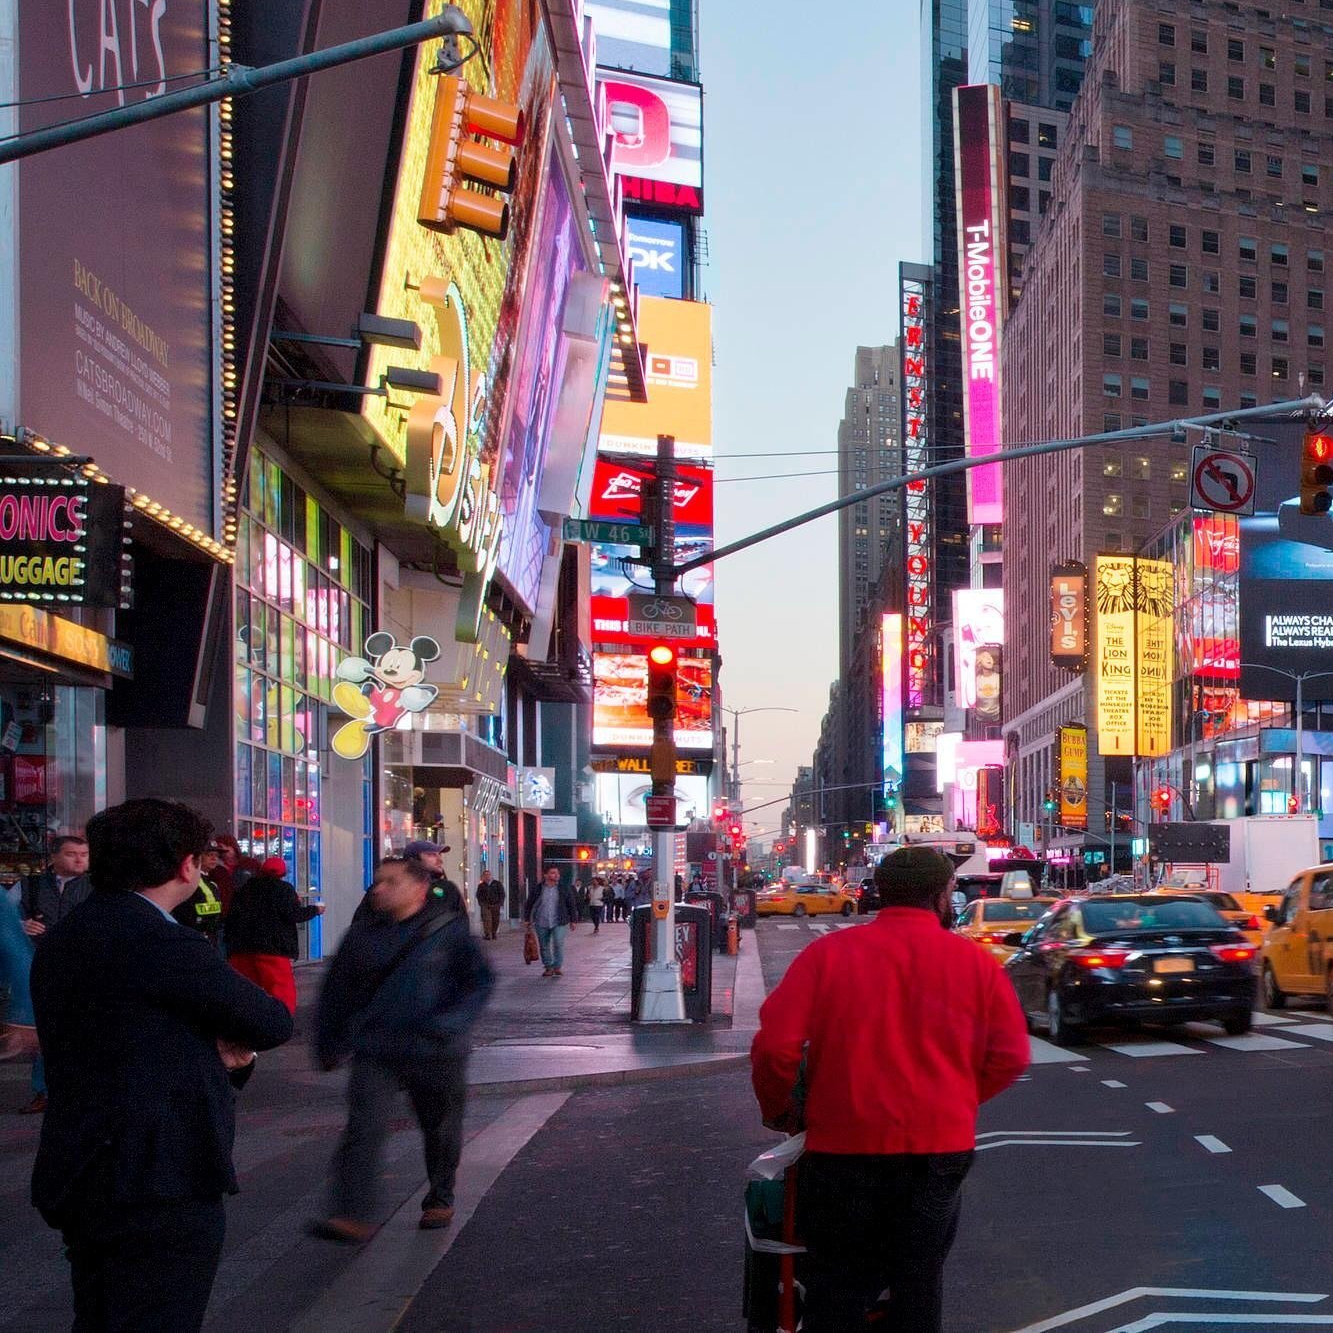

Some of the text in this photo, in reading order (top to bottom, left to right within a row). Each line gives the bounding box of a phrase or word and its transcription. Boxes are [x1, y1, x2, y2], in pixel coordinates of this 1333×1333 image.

[965, 217, 994, 384] T-MobileONE
[74, 258, 102, 308] BACK
[103, 286, 119, 322] ON
[122, 300, 169, 368] BROADWAY
[905, 294, 928, 670] ERNST YOUNG
[584, 522, 600, 539] W
[608, 526, 631, 542] 46
[1272, 616, 1310, 627] ALWAYS
[635, 622, 657, 634] BIKE
[665, 623, 690, 636] PATH
[1272, 626, 1310, 637] ALWAYS
[1106, 637, 1123, 645] THE
[1272, 637, 1288, 647] The
[1289, 637, 1313, 647] Lexus
[1103, 647, 1127, 660] LION
[1102, 661, 1131, 677] KING
[1062, 732, 1086, 745] BUBBA
[1064, 746, 1085, 757] GUMP
[617, 758, 651, 772] WALL
